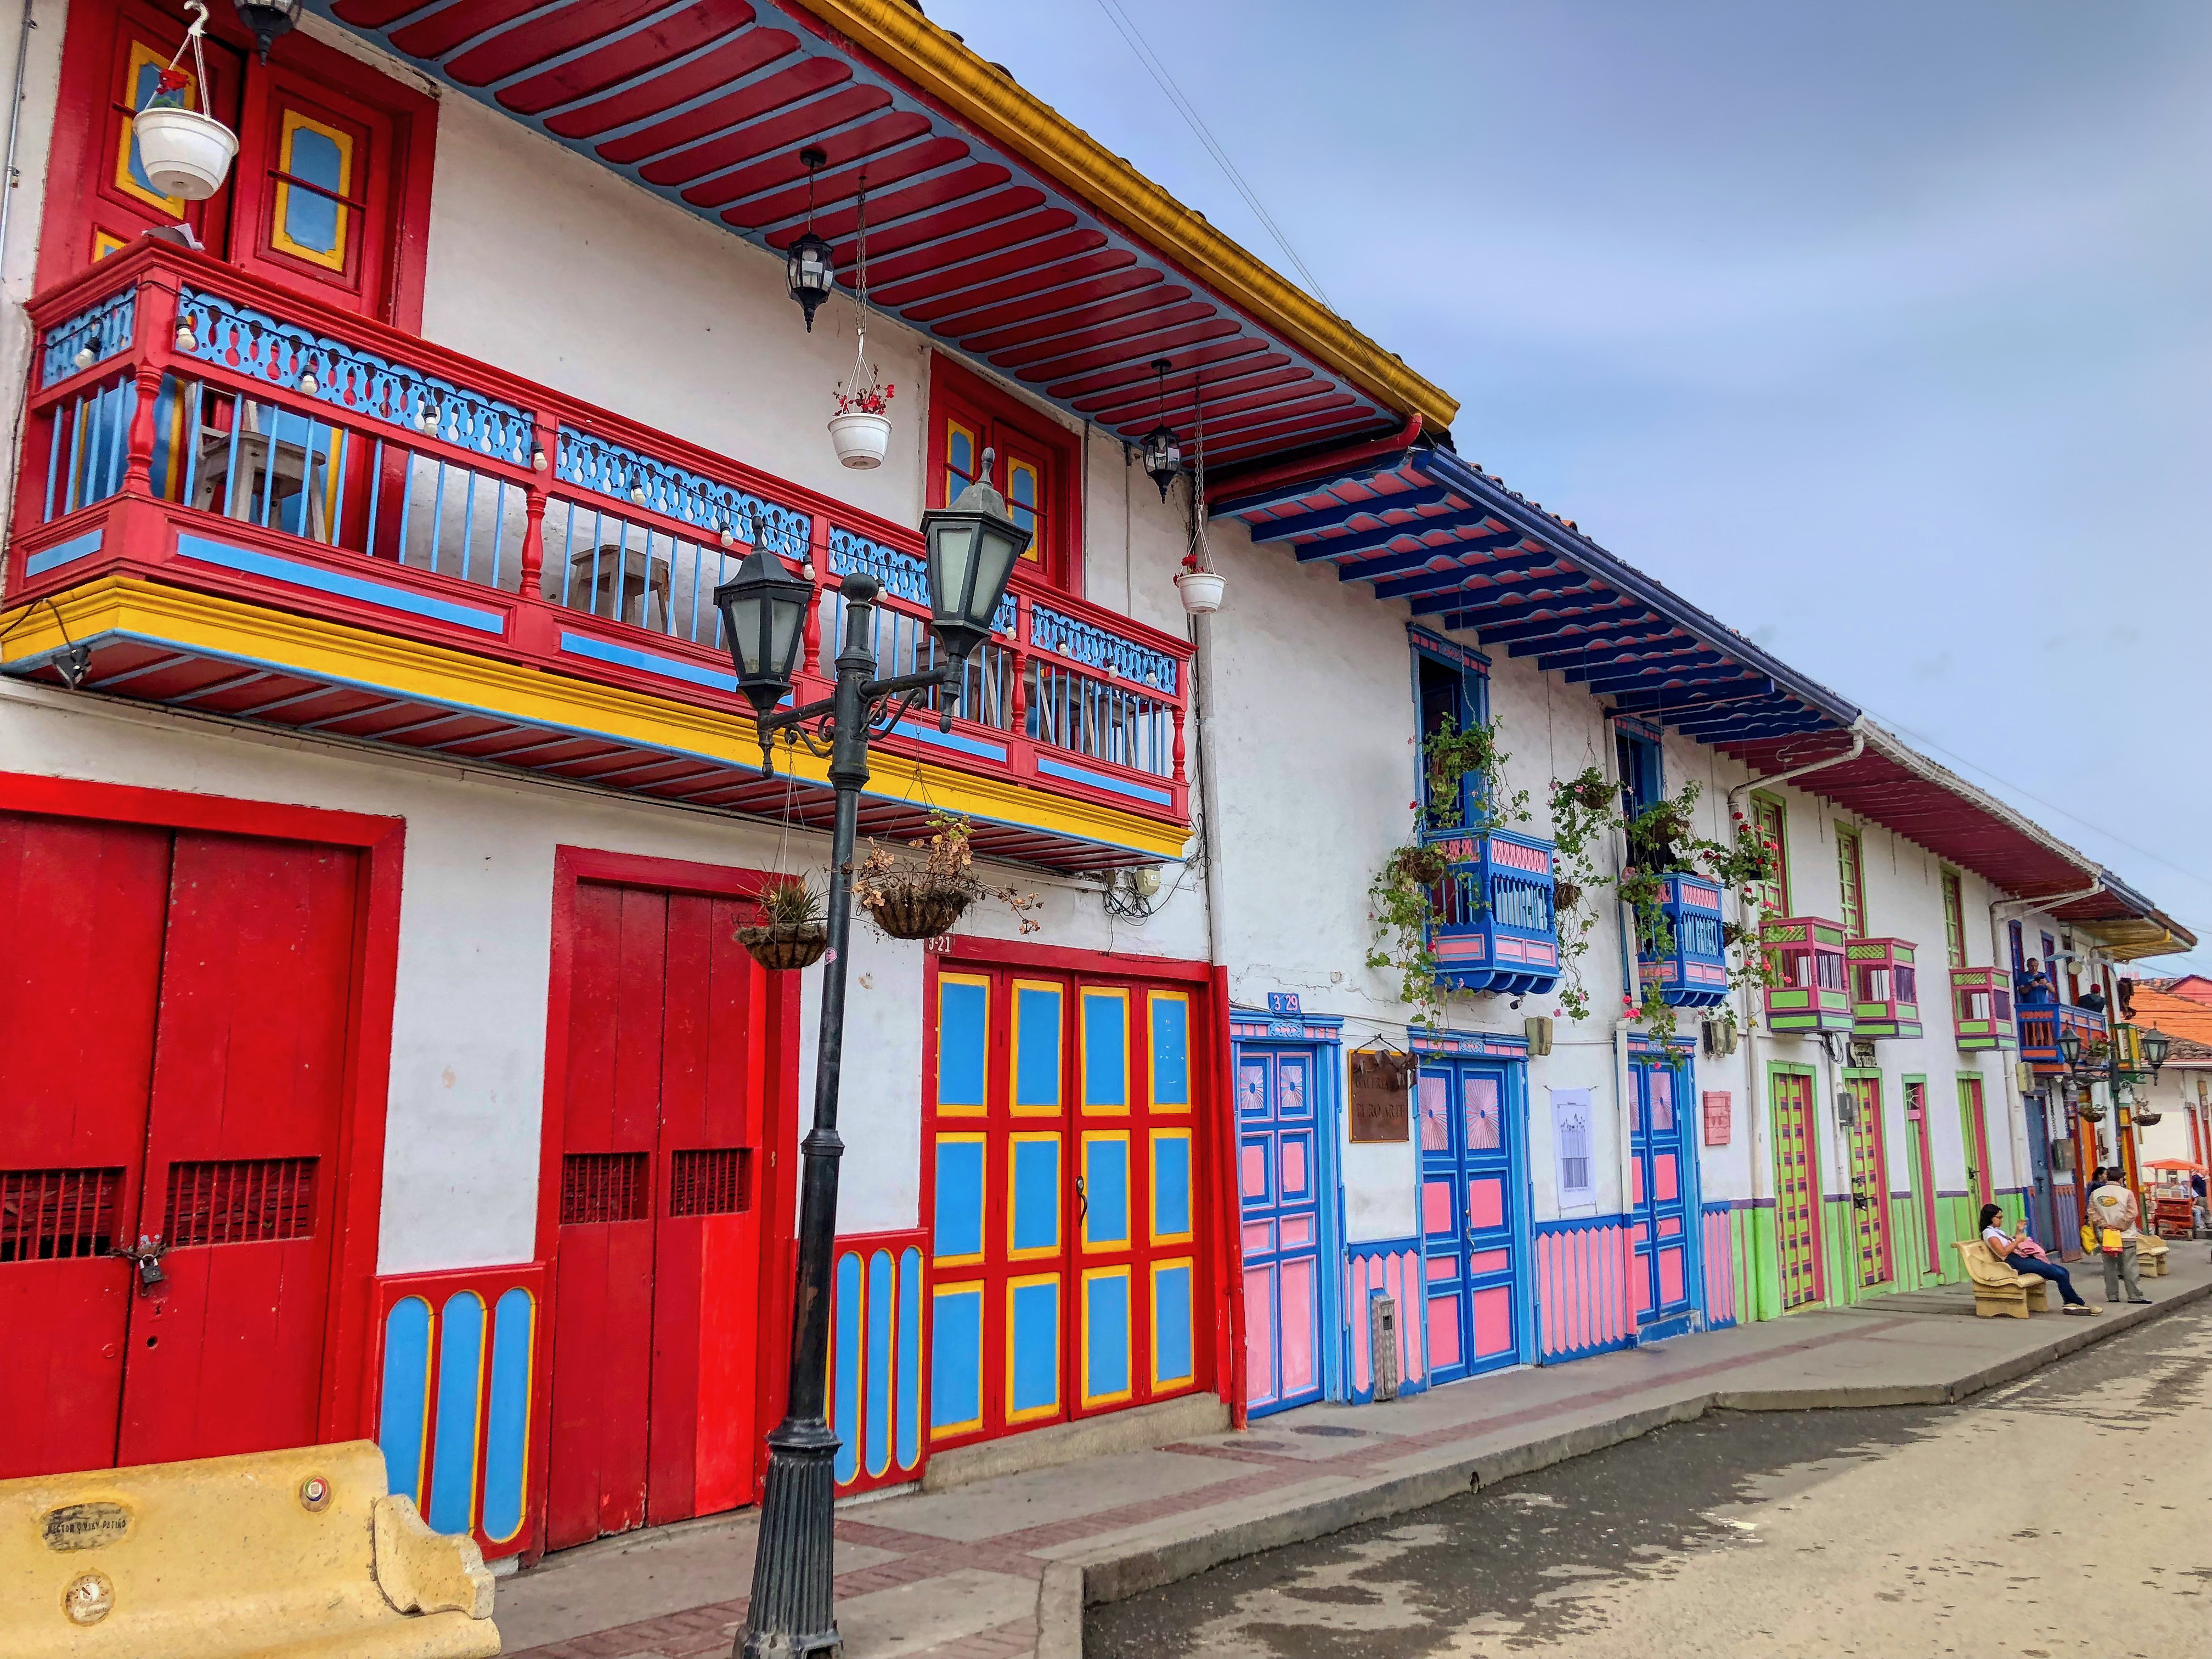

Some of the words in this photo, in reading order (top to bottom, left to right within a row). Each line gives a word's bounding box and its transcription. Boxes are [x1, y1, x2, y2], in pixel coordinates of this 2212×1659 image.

[1273, 995, 1280, 1011] 3
[1285, 995, 1298, 1011] 29
[1356, 1103, 1381, 1118] PURO
[1385, 1104, 1406, 1119] ARTE
